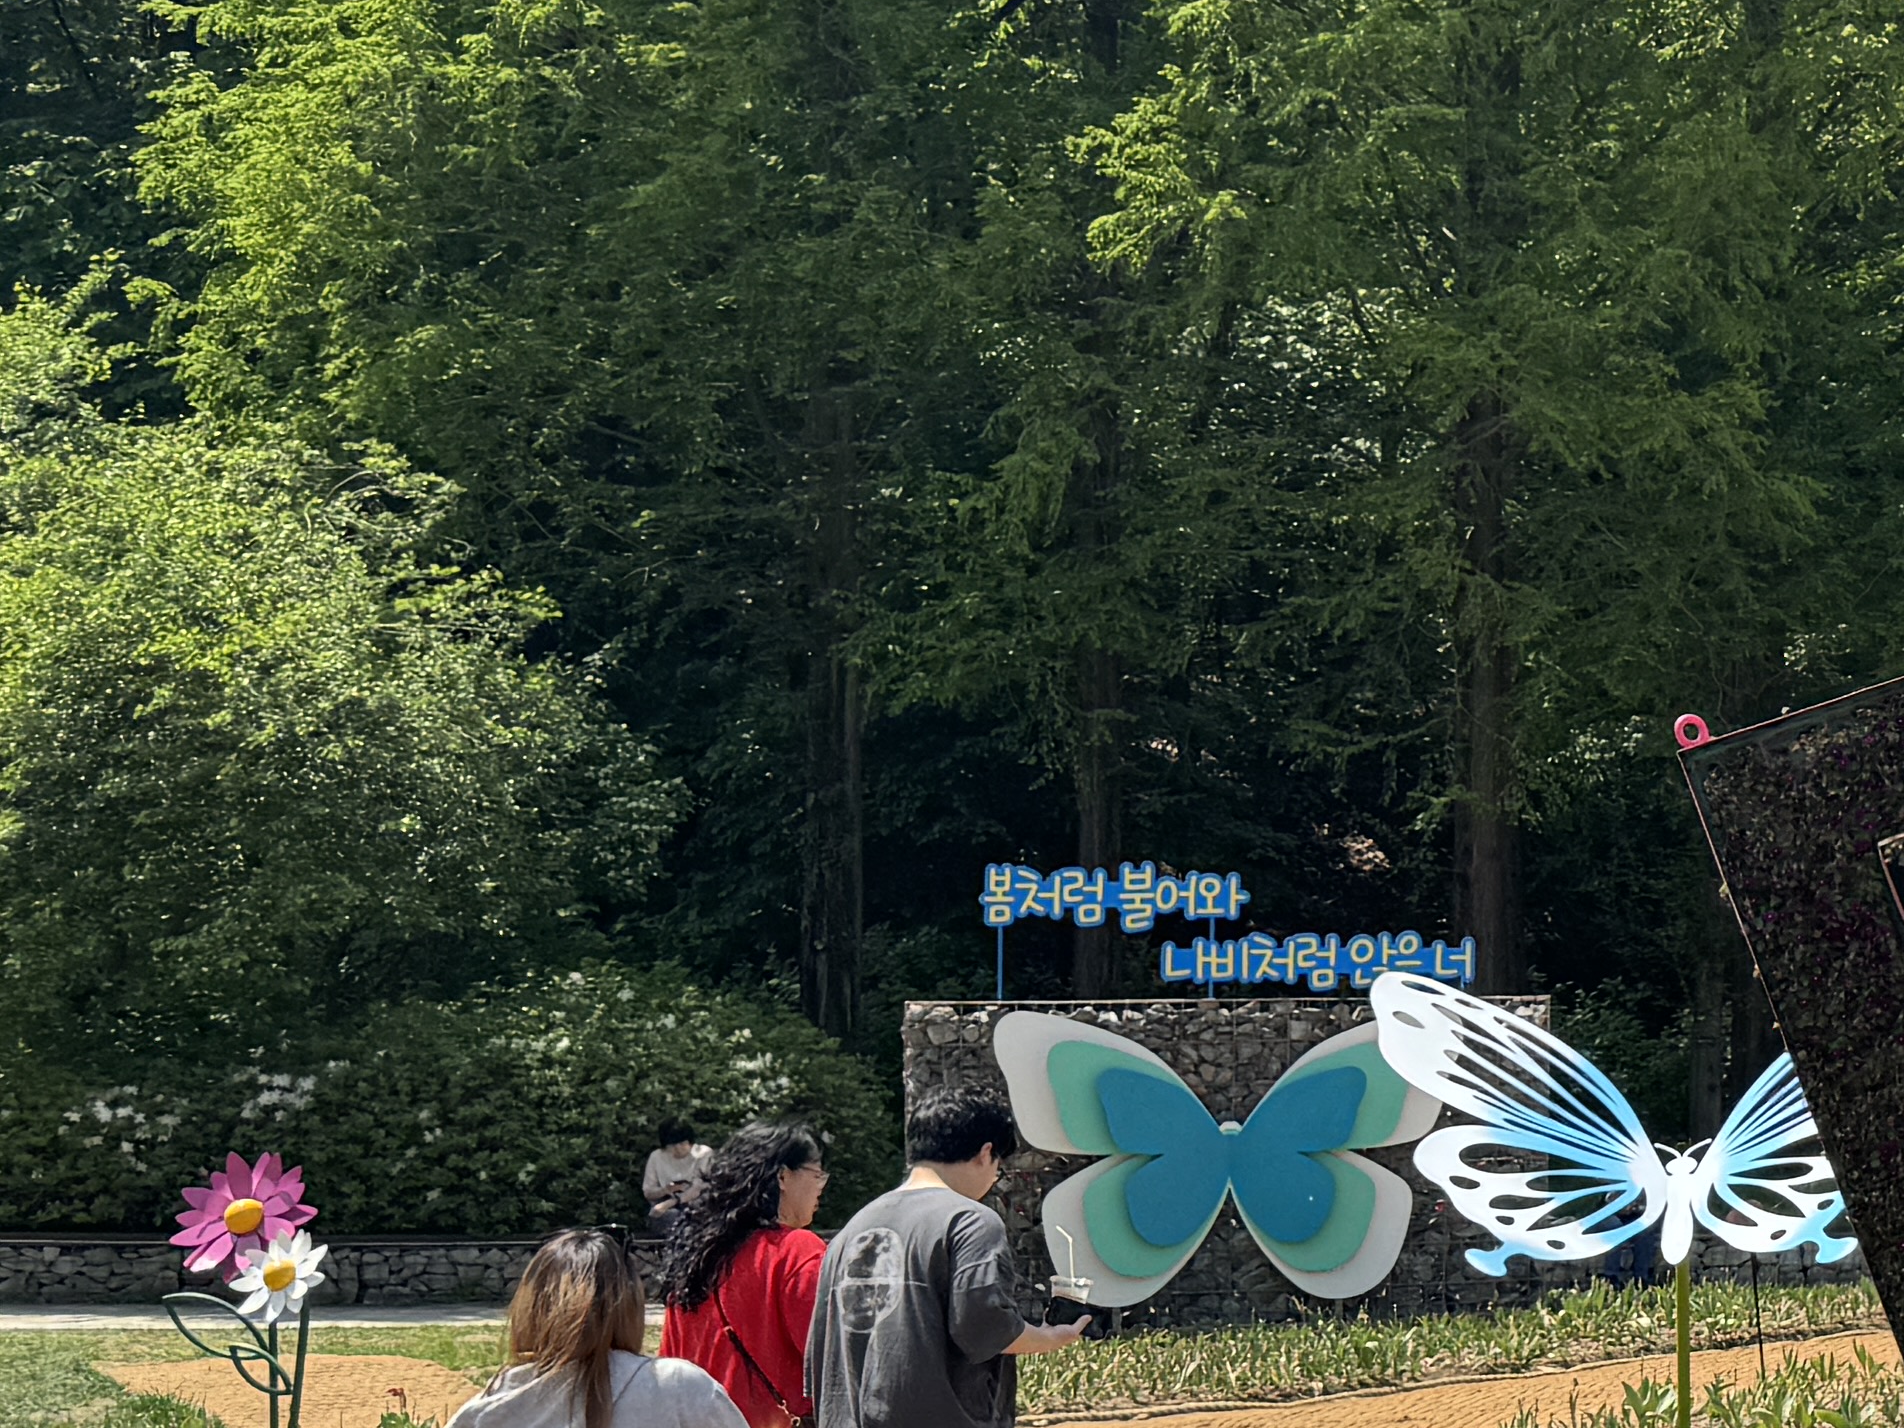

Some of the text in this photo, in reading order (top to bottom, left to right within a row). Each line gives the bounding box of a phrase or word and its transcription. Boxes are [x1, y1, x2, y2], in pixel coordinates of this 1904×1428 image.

[984, 864, 1249, 929] 봄처럼 불어와
[1164, 933, 1472, 989] 나비처럼 앉은 너
